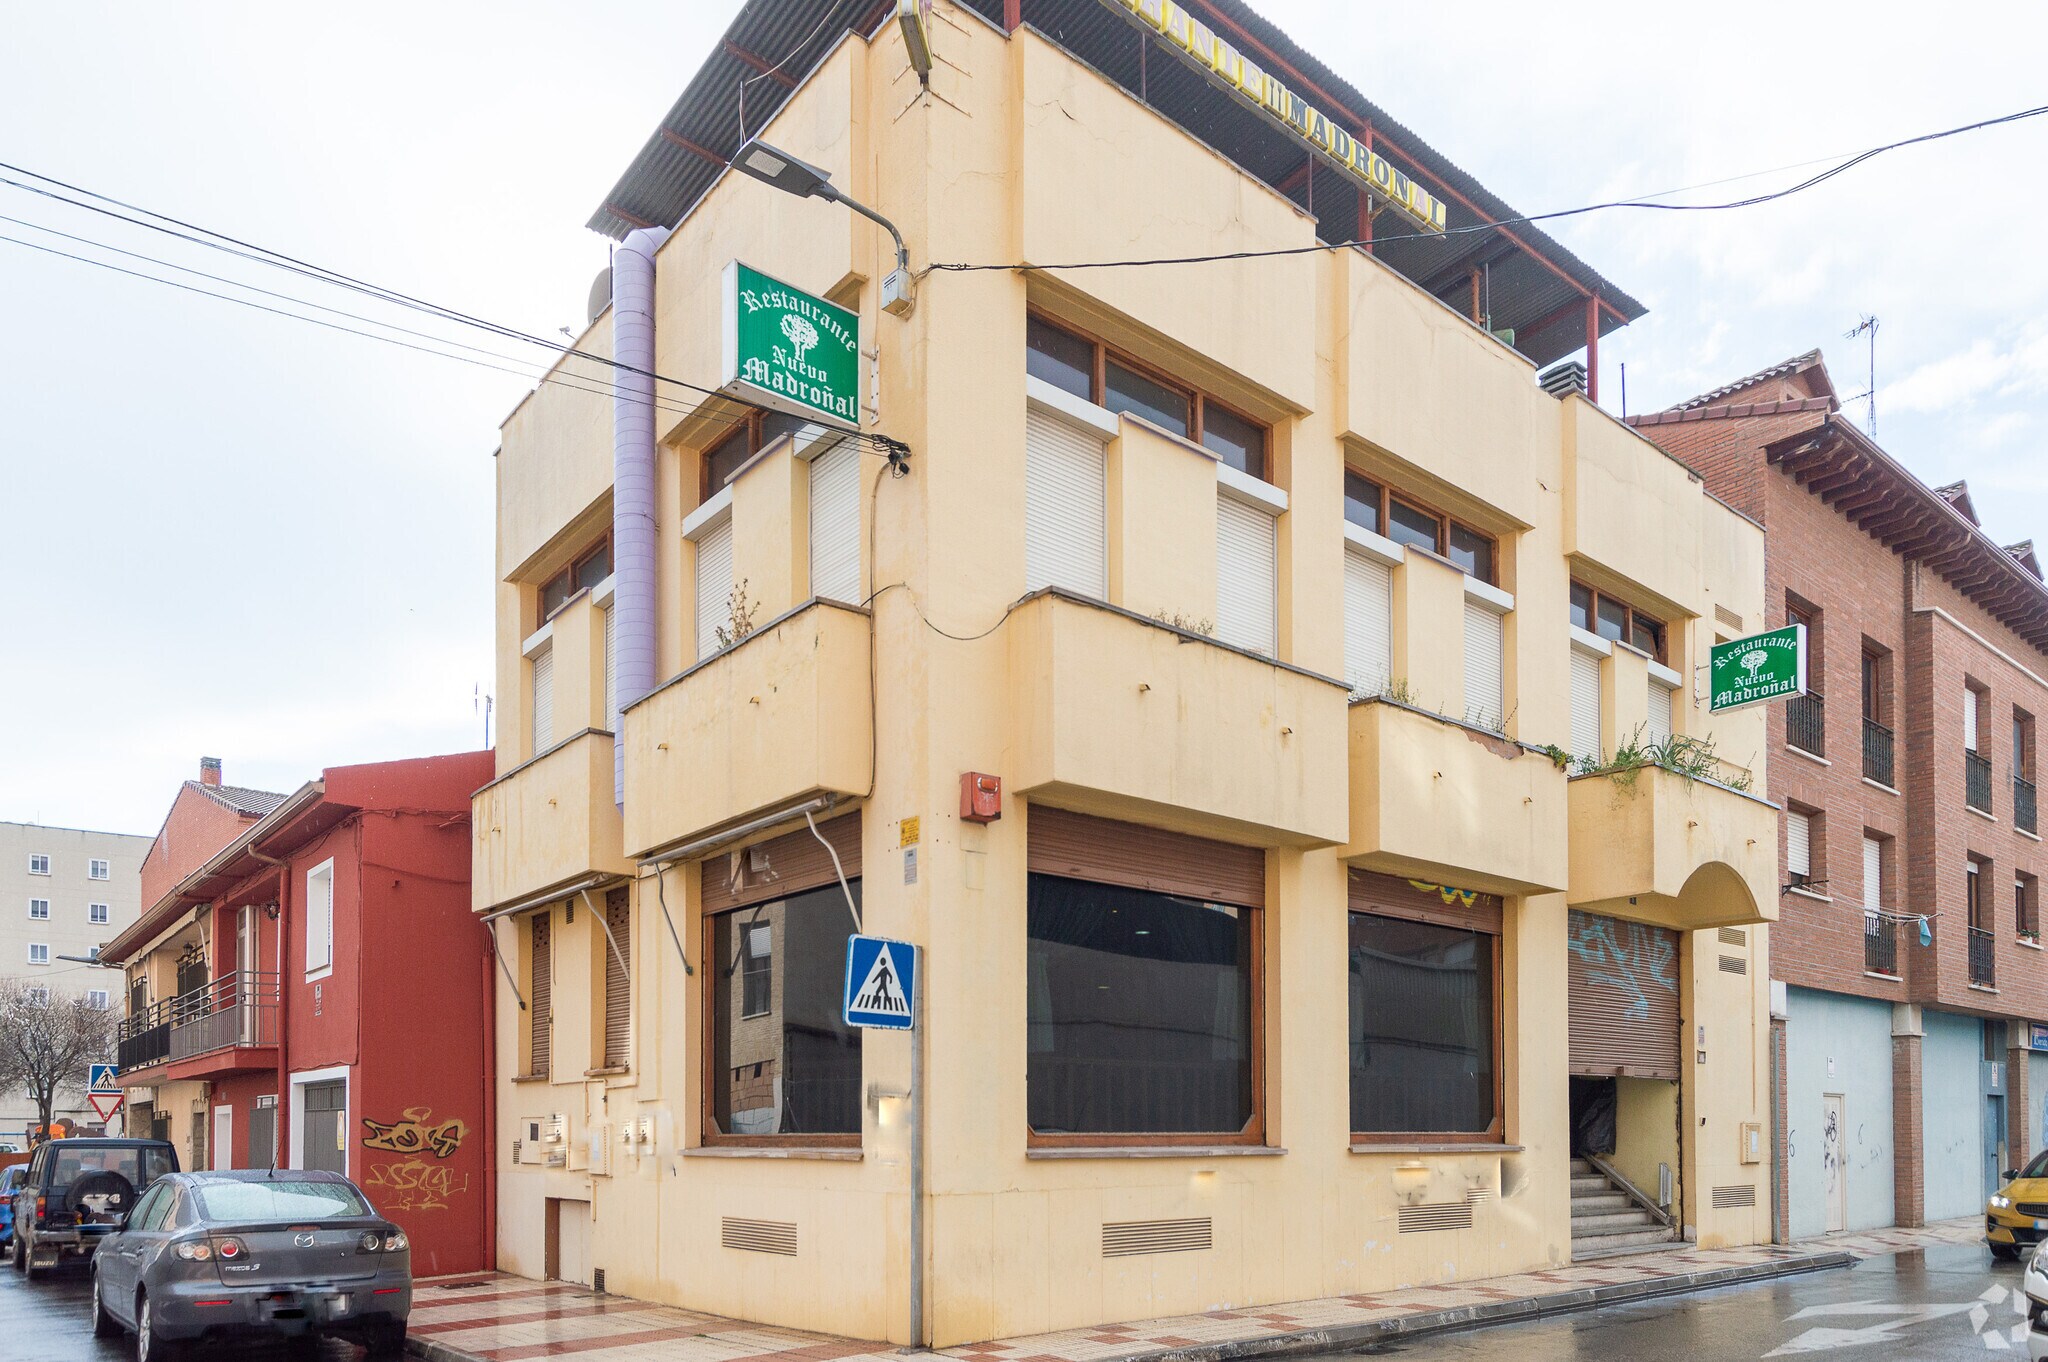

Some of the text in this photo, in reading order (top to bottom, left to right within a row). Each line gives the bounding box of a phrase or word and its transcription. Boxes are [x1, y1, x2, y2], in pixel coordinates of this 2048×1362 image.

[740, 289, 857, 352] Restaurante
[772, 345, 828, 383] Nuevo
[741, 357, 856, 418] Madroñal
[1713, 637, 1797, 670] Restaurante
[1713, 675, 1796, 709] Madroñal
[1734, 672, 1774, 689] Nuevo
